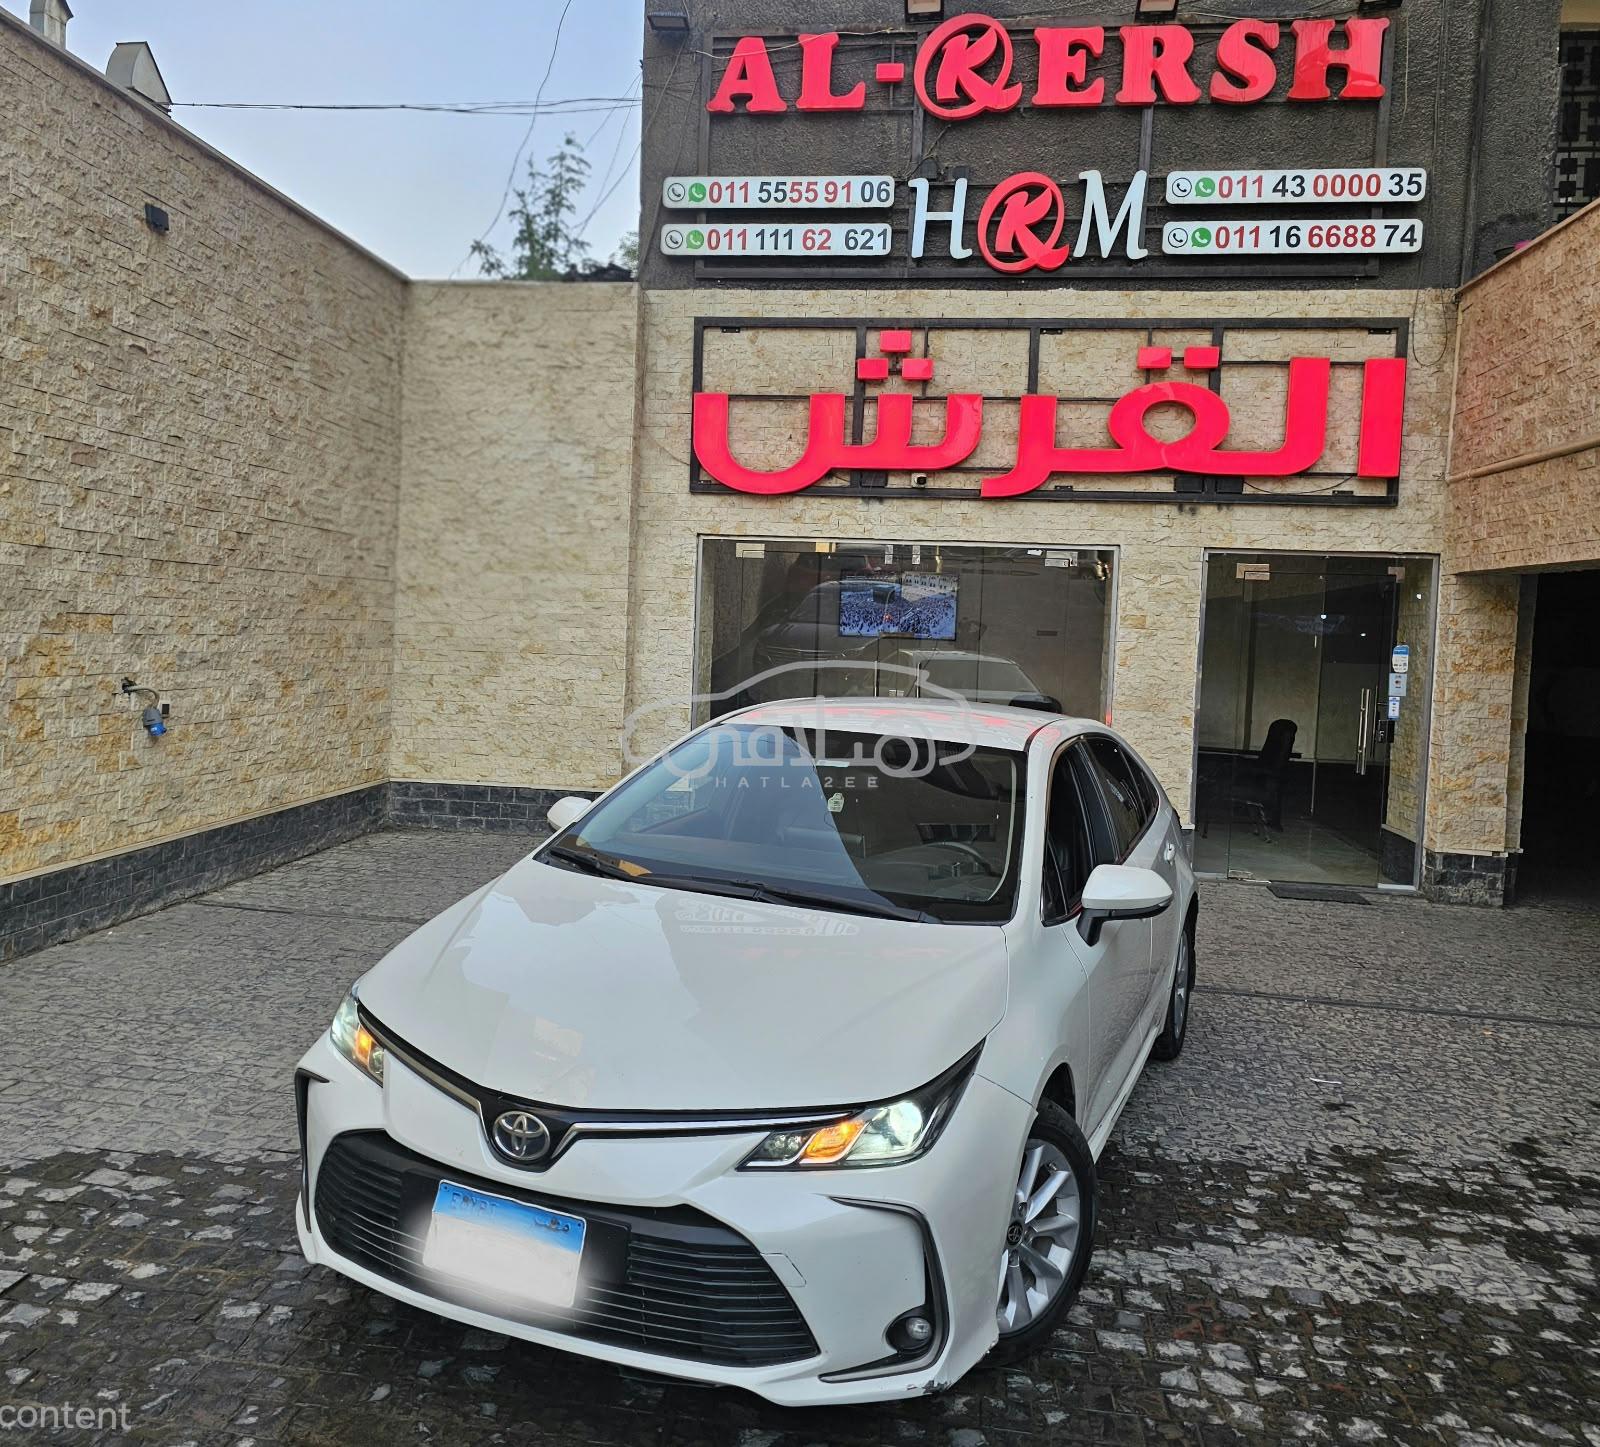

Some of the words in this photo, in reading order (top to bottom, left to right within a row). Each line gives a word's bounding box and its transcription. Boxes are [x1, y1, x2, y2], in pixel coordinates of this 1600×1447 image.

[708, 181, 750, 204] 011
[860, 180, 891, 203] 06
[1217, 174, 1264, 199] 011
[1271, 174, 1306, 198] 43
[1312, 173, 1382, 198] 0000
[1388, 172, 1422, 197] 35
[706, 228, 748, 251] 011
[754, 228, 794, 251] 111
[801, 228, 832, 251] 62
[844, 228, 888, 251] 621
[1214, 225, 1261, 249] 011
[1269, 225, 1302, 249] 16
[1307, 224, 1377, 249] 6688
[1383, 224, 1418, 248] 74
[693, 329, 1407, 498] القرش
